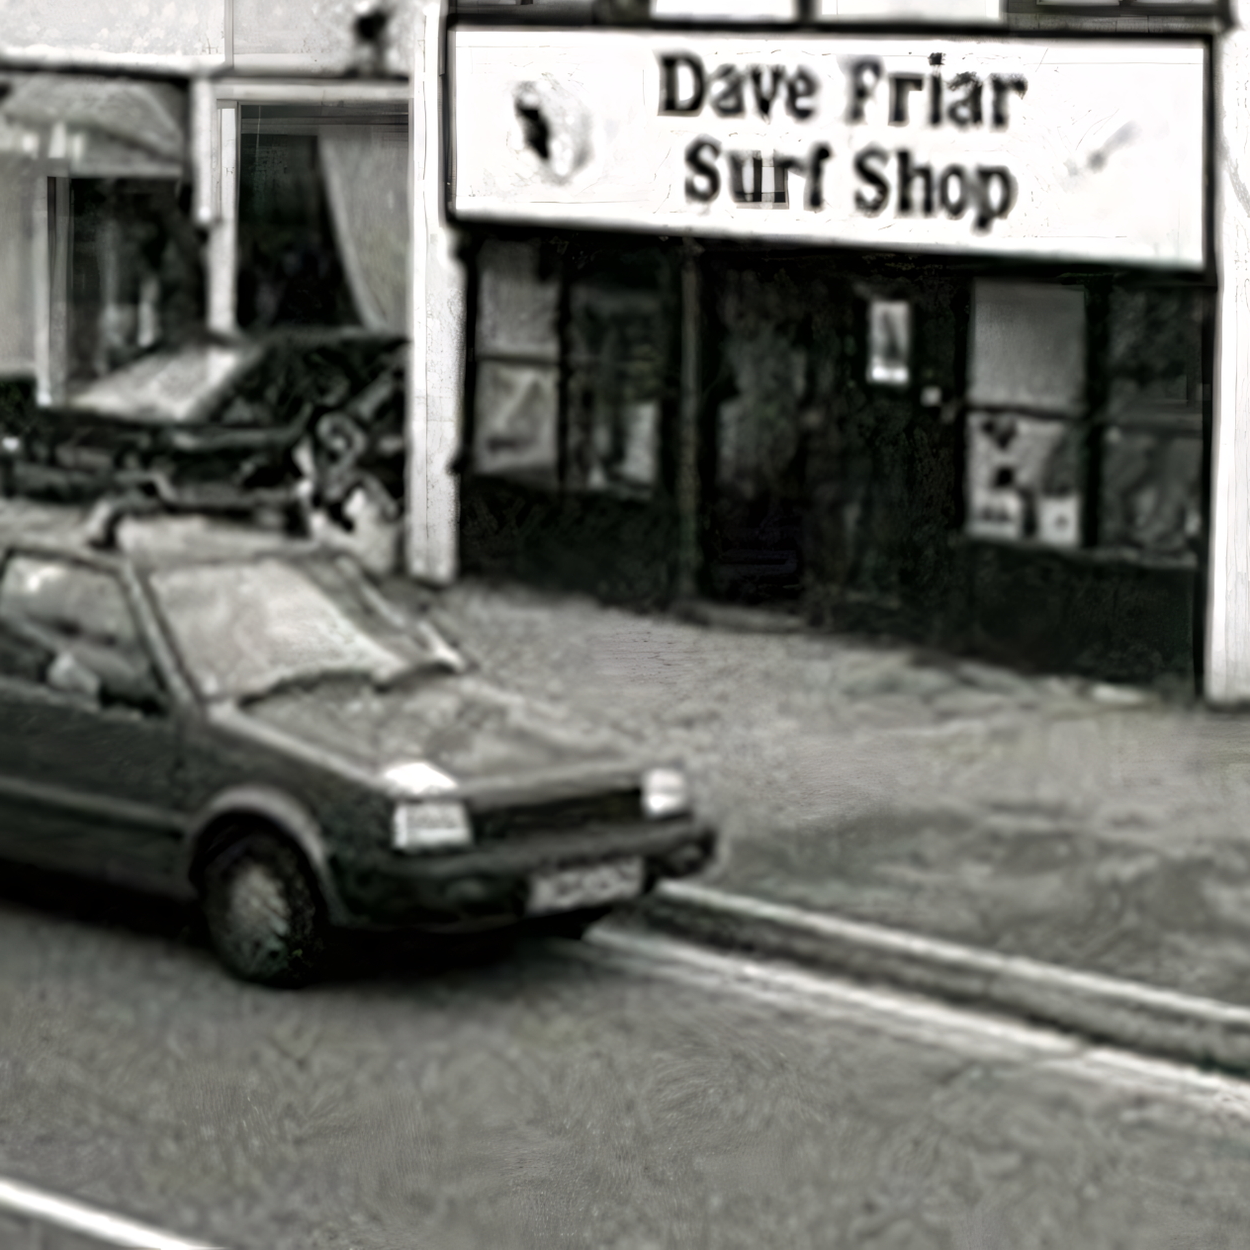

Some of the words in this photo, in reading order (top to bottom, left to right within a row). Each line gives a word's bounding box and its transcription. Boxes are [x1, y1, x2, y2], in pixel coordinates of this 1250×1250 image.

[656, 50, 818, 123] Dave
[845, 52, 1028, 130] Friar
[684, 136, 833, 210] Surf
[853, 143, 1017, 234] Shop
